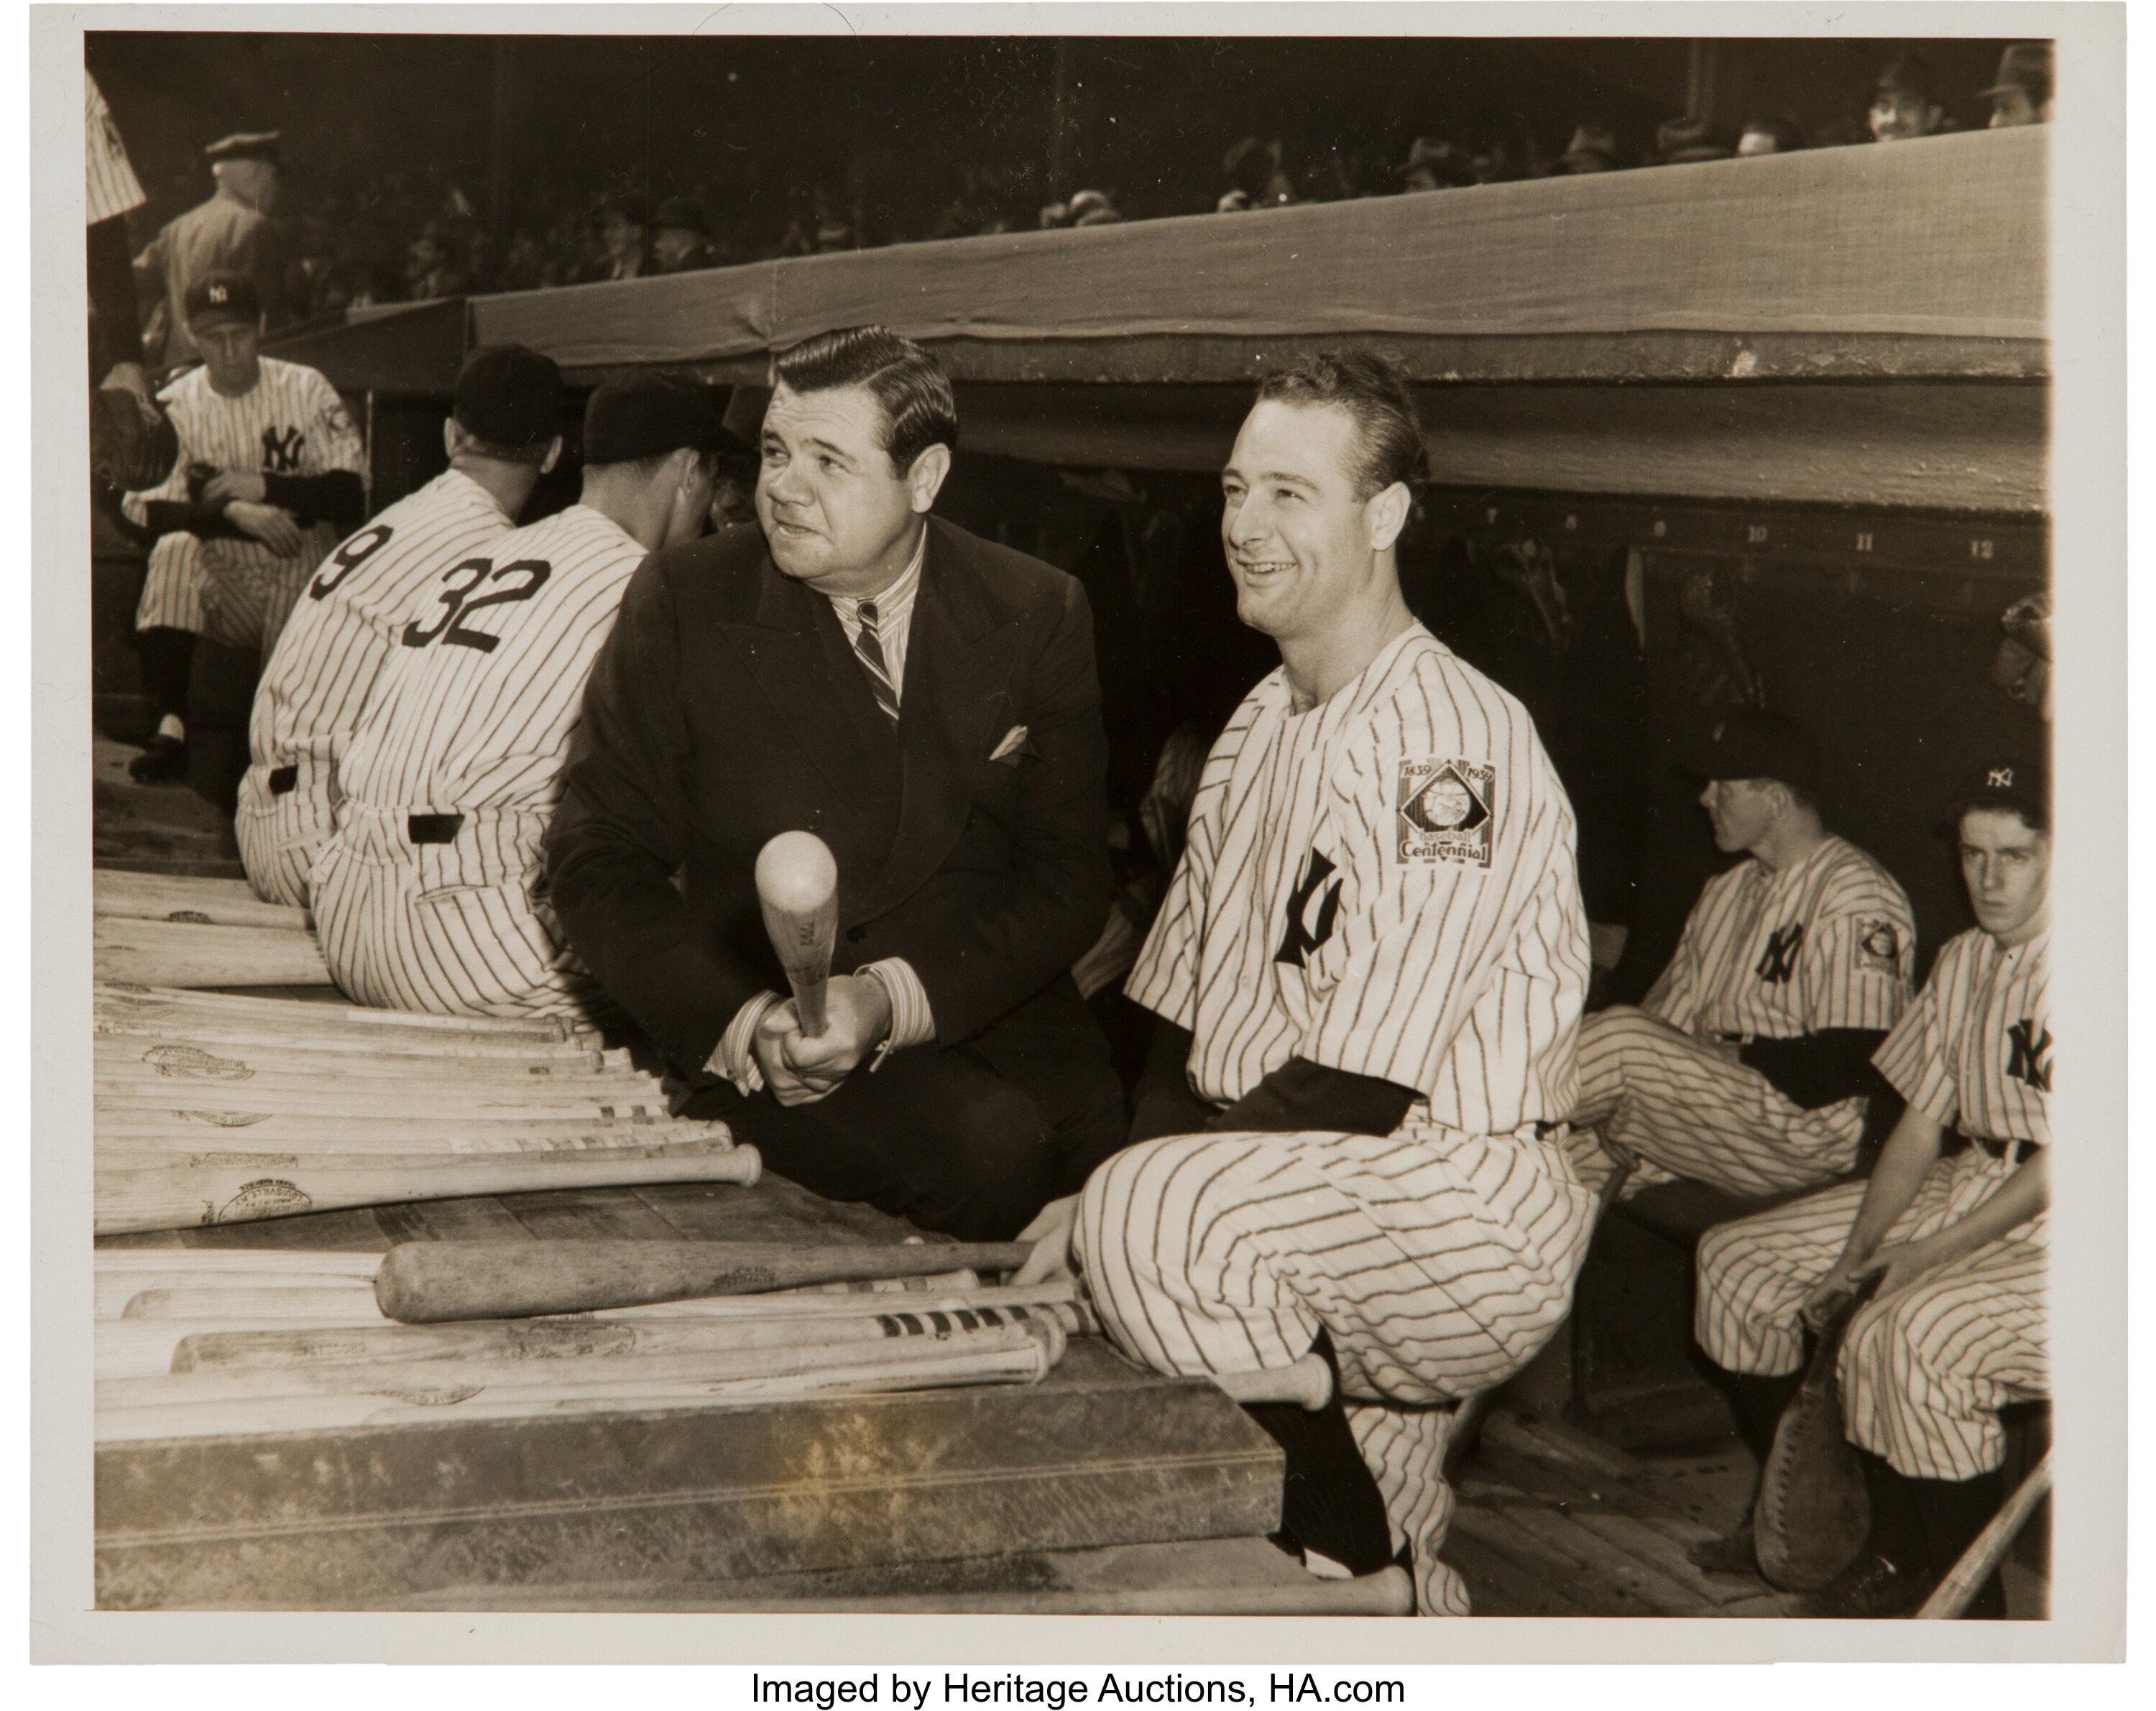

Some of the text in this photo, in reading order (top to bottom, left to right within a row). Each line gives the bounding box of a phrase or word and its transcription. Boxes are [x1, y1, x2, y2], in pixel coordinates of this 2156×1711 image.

[262, 425, 305, 471] NY
[1487, 507, 1499, 525] 7
[1748, 525, 1767, 543] 10
[1856, 533, 1874, 552] 11
[1971, 540, 1994, 559] 12
[309, 524, 394, 601] 9
[401, 557, 552, 655] 32
[1404, 765, 1432, 778] 1839
[1466, 767, 1494, 782] 1939
[1986, 767, 2014, 788] NY
[1401, 841, 1487, 861] Centennial
[1755, 920, 1804, 984] NY
[2007, 1018, 2054, 1094] NY
